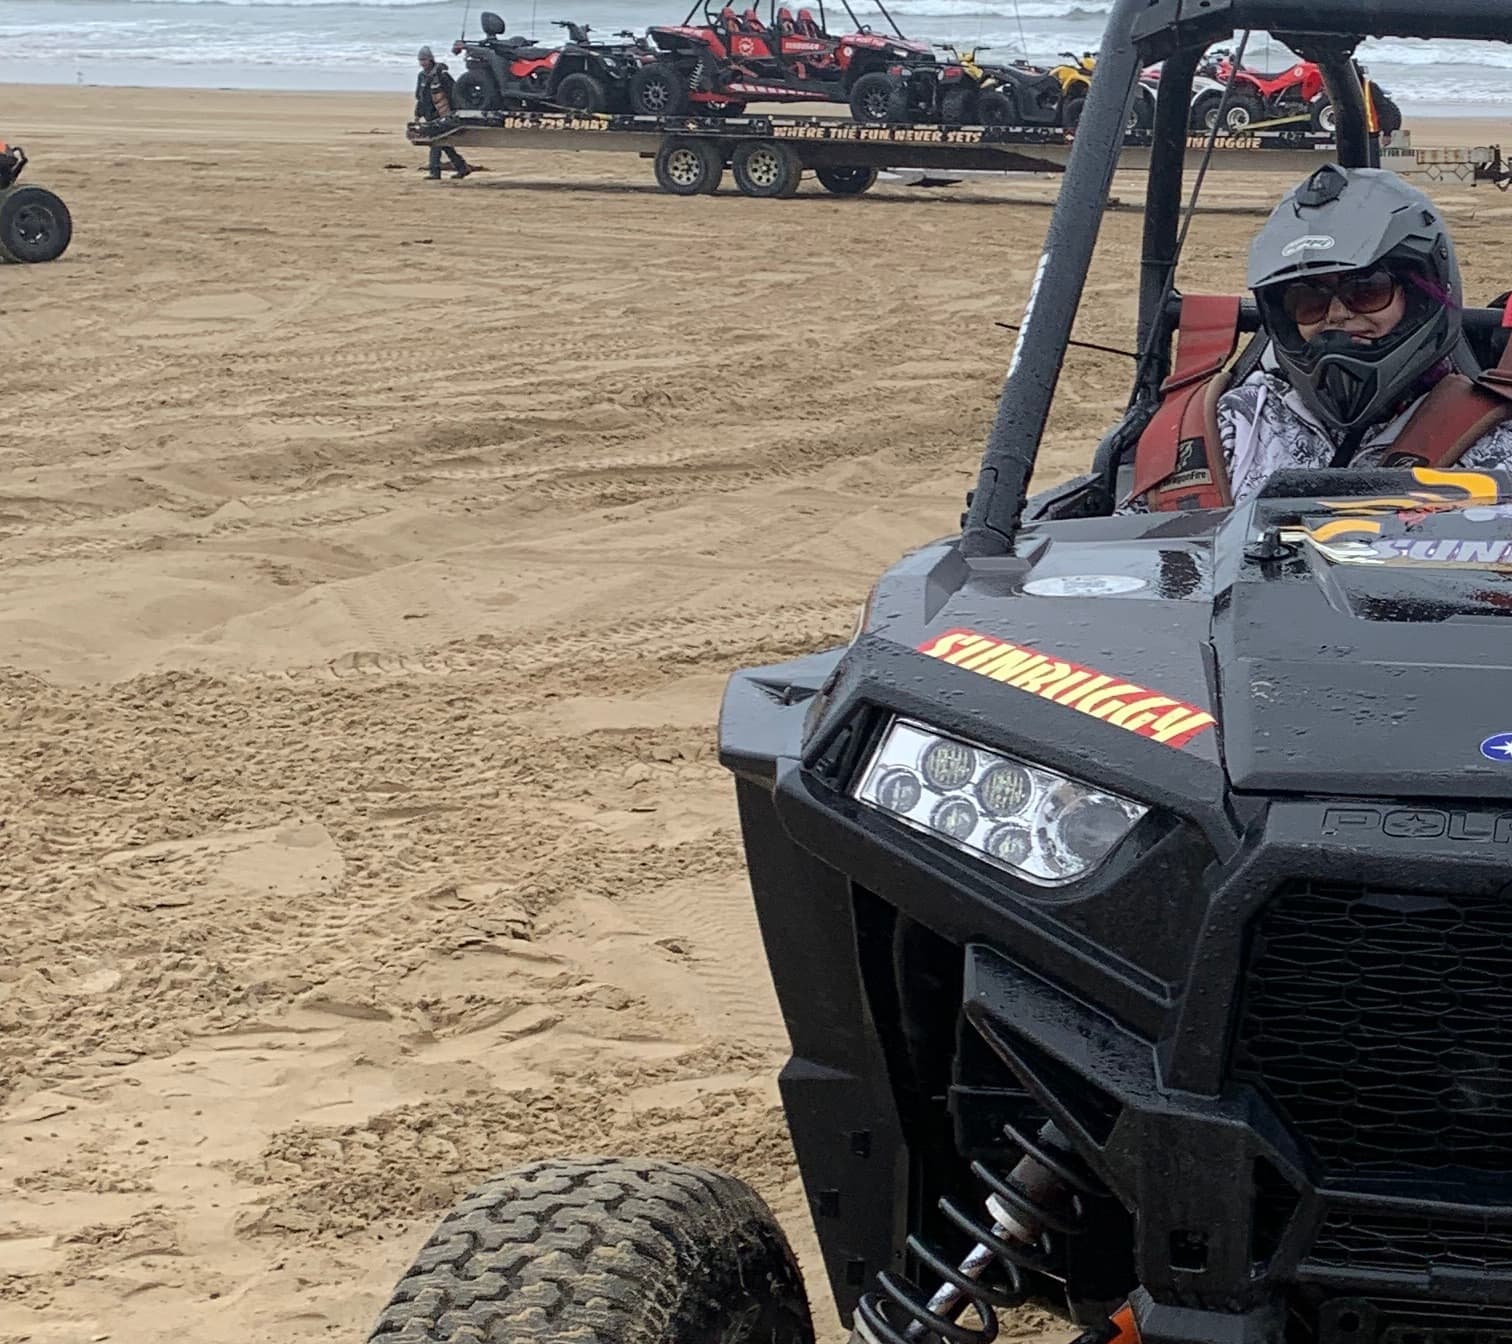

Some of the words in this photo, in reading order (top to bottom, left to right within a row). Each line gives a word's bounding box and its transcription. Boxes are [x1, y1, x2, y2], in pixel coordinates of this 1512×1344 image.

[773, 127, 825, 139] WHERE
[829, 127, 858, 140] THE
[860, 128, 891, 141] FUN
[894, 129, 942, 142] NEVER
[947, 130, 983, 144] SETS
[922, 631, 1218, 743] SUNBUGGY
